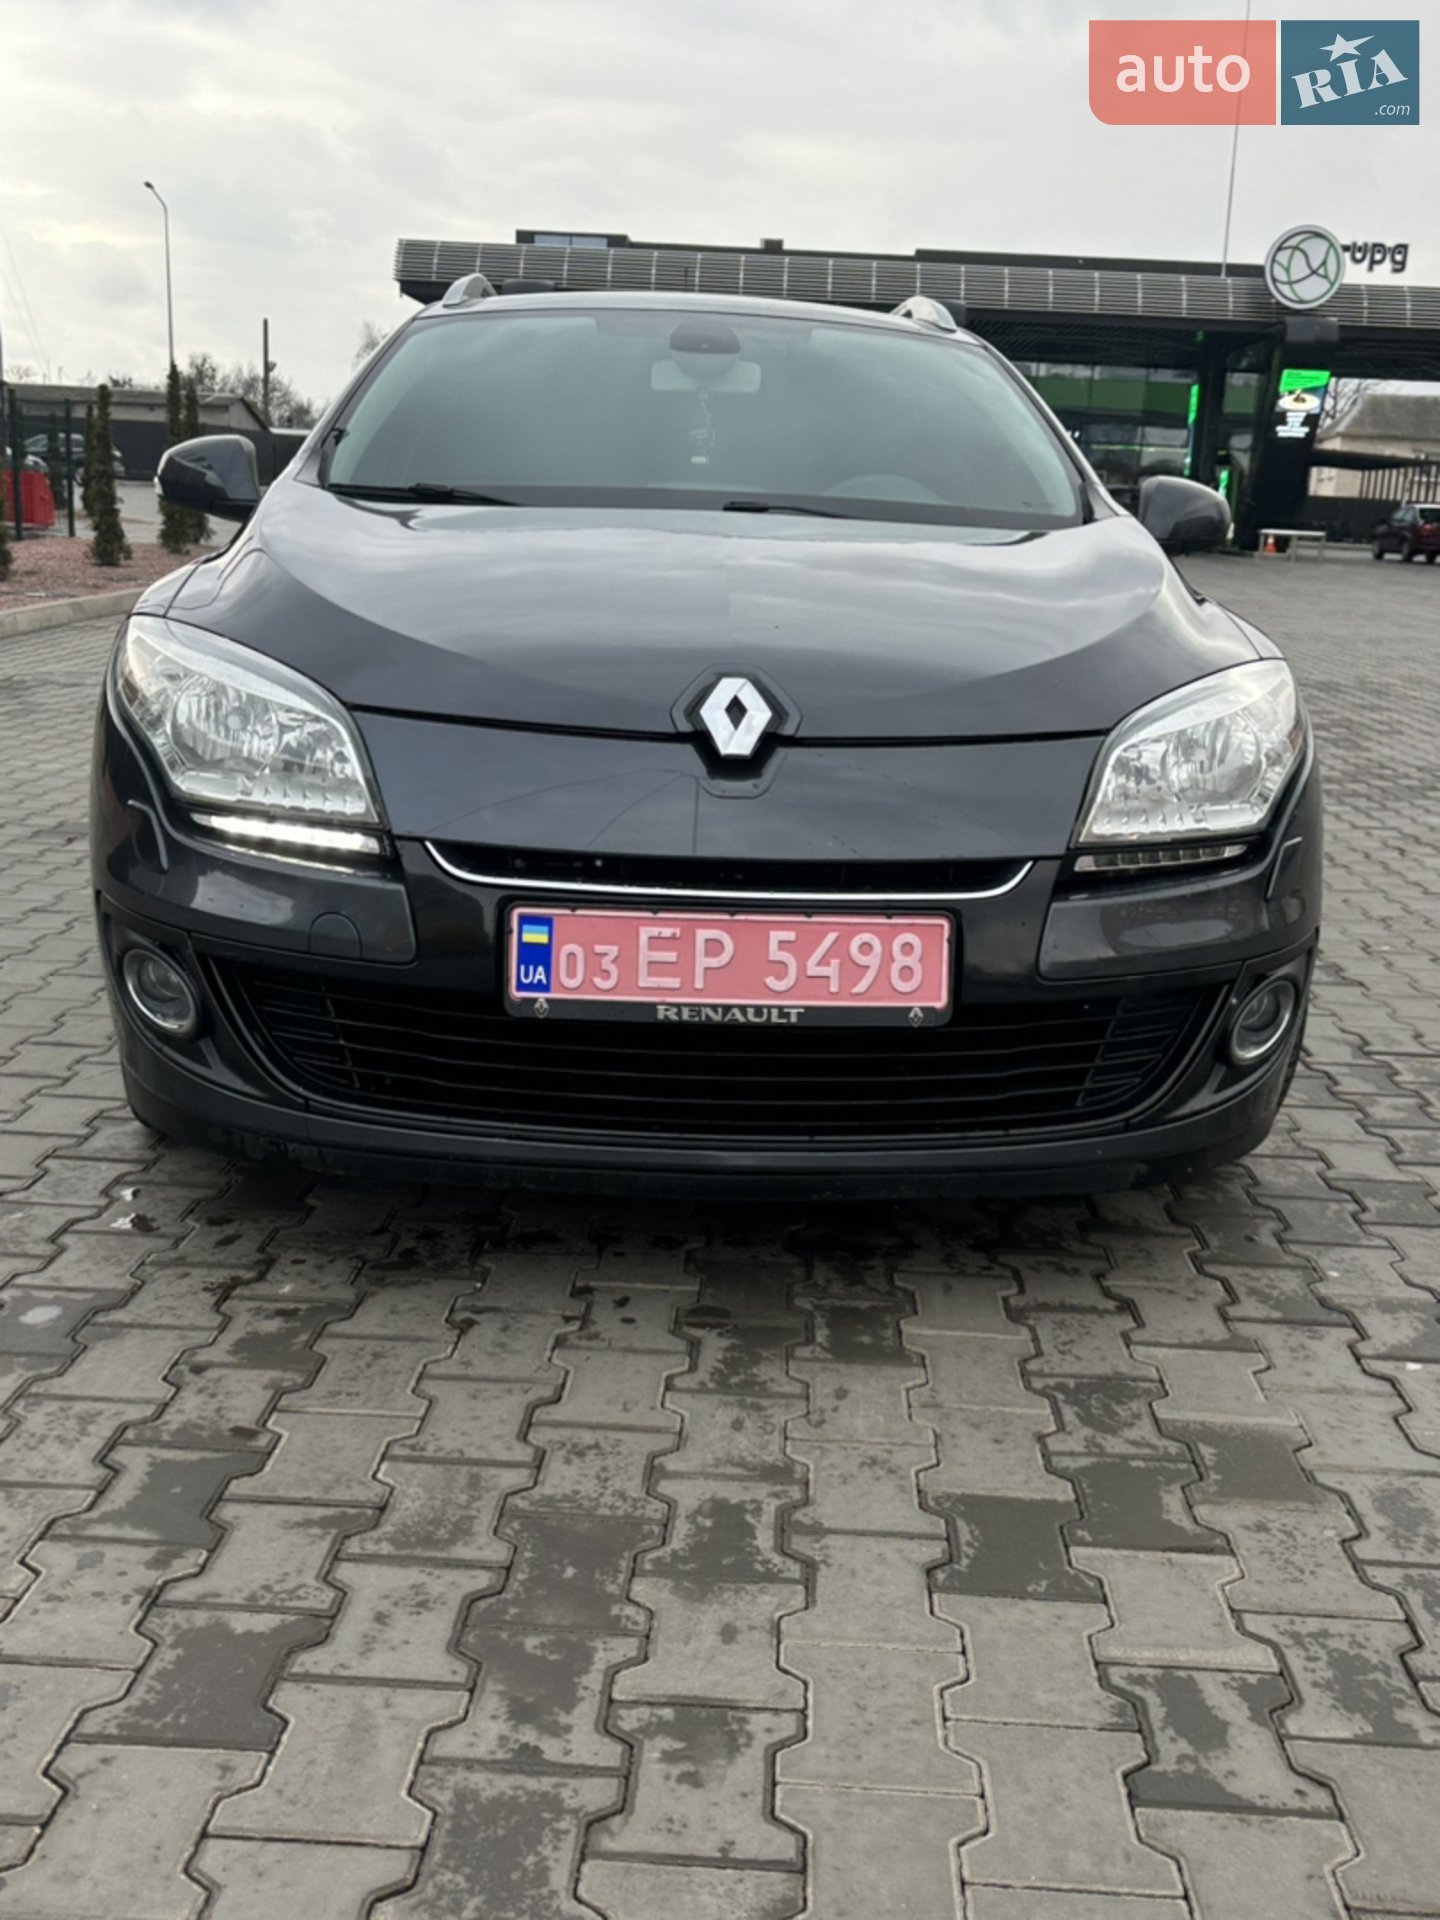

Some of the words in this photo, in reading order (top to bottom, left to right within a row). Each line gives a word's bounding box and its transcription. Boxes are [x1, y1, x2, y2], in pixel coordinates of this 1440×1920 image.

[1350, 241, 1409, 273] upg
[559, 943, 619, 990] 03
[638, 926, 734, 990] EP
[763, 930, 923, 994] 5498
[520, 964, 547, 984] UA
[656, 1005, 805, 1023] RENAULT
